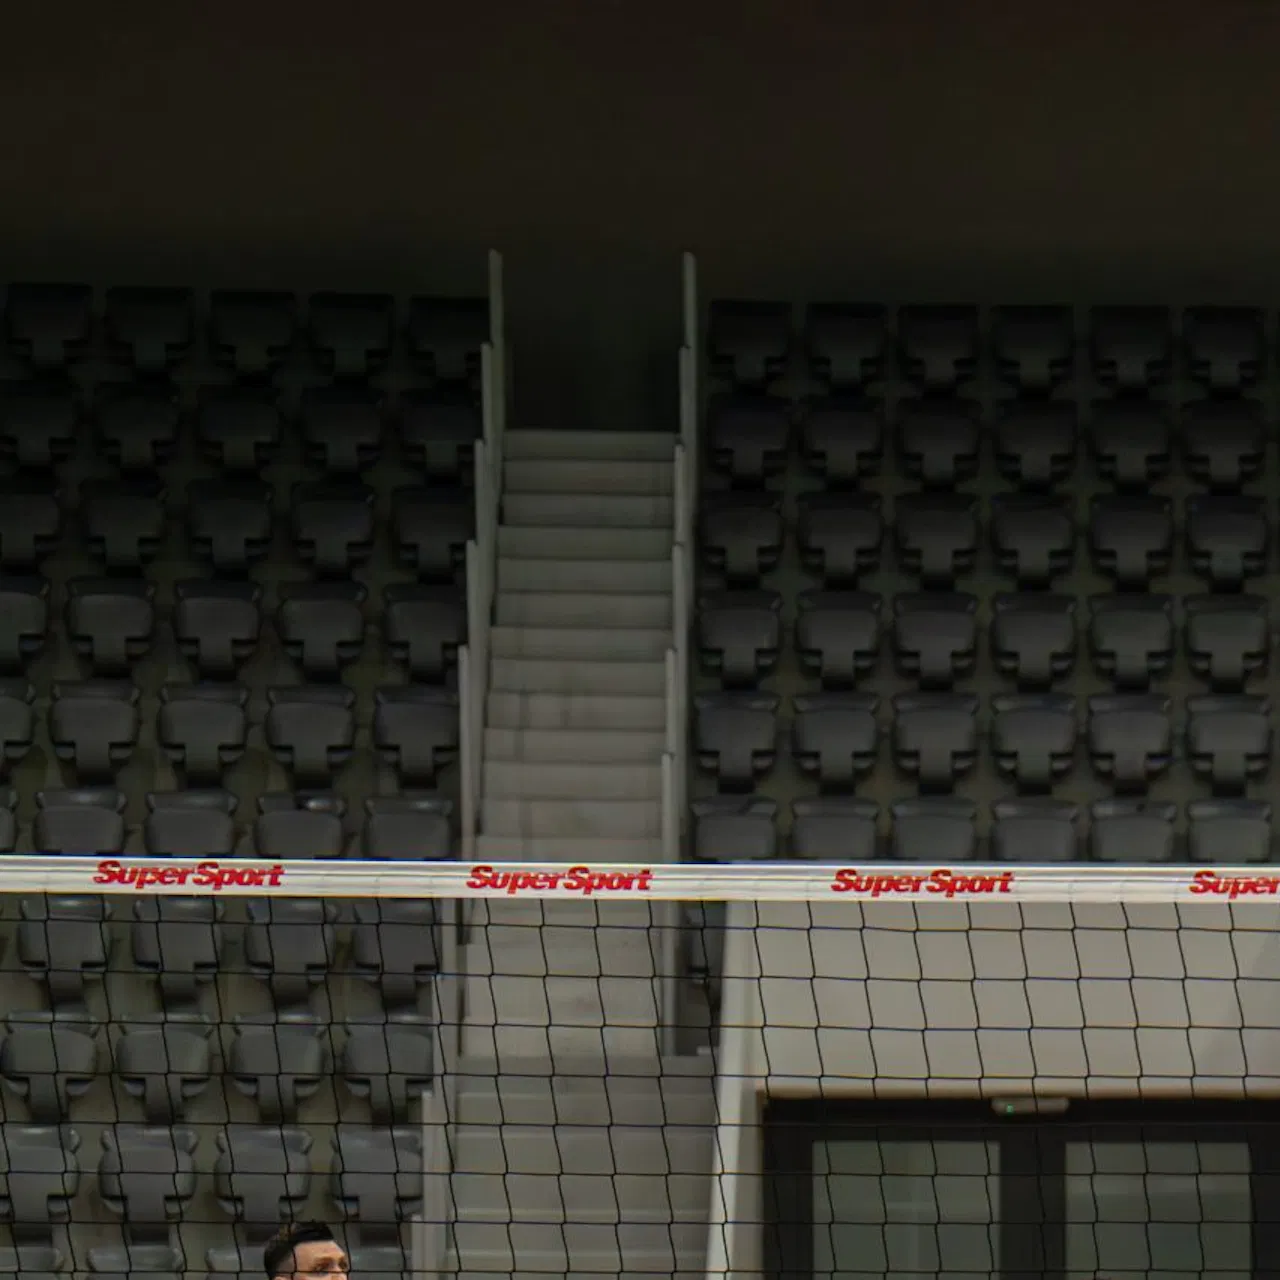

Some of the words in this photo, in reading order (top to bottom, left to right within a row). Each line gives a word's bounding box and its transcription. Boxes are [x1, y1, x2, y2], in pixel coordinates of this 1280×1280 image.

[93, 860, 285, 890] SuperSport
[465, 865, 655, 895] SuperSport
[830, 868, 1014, 898] SuperSport
